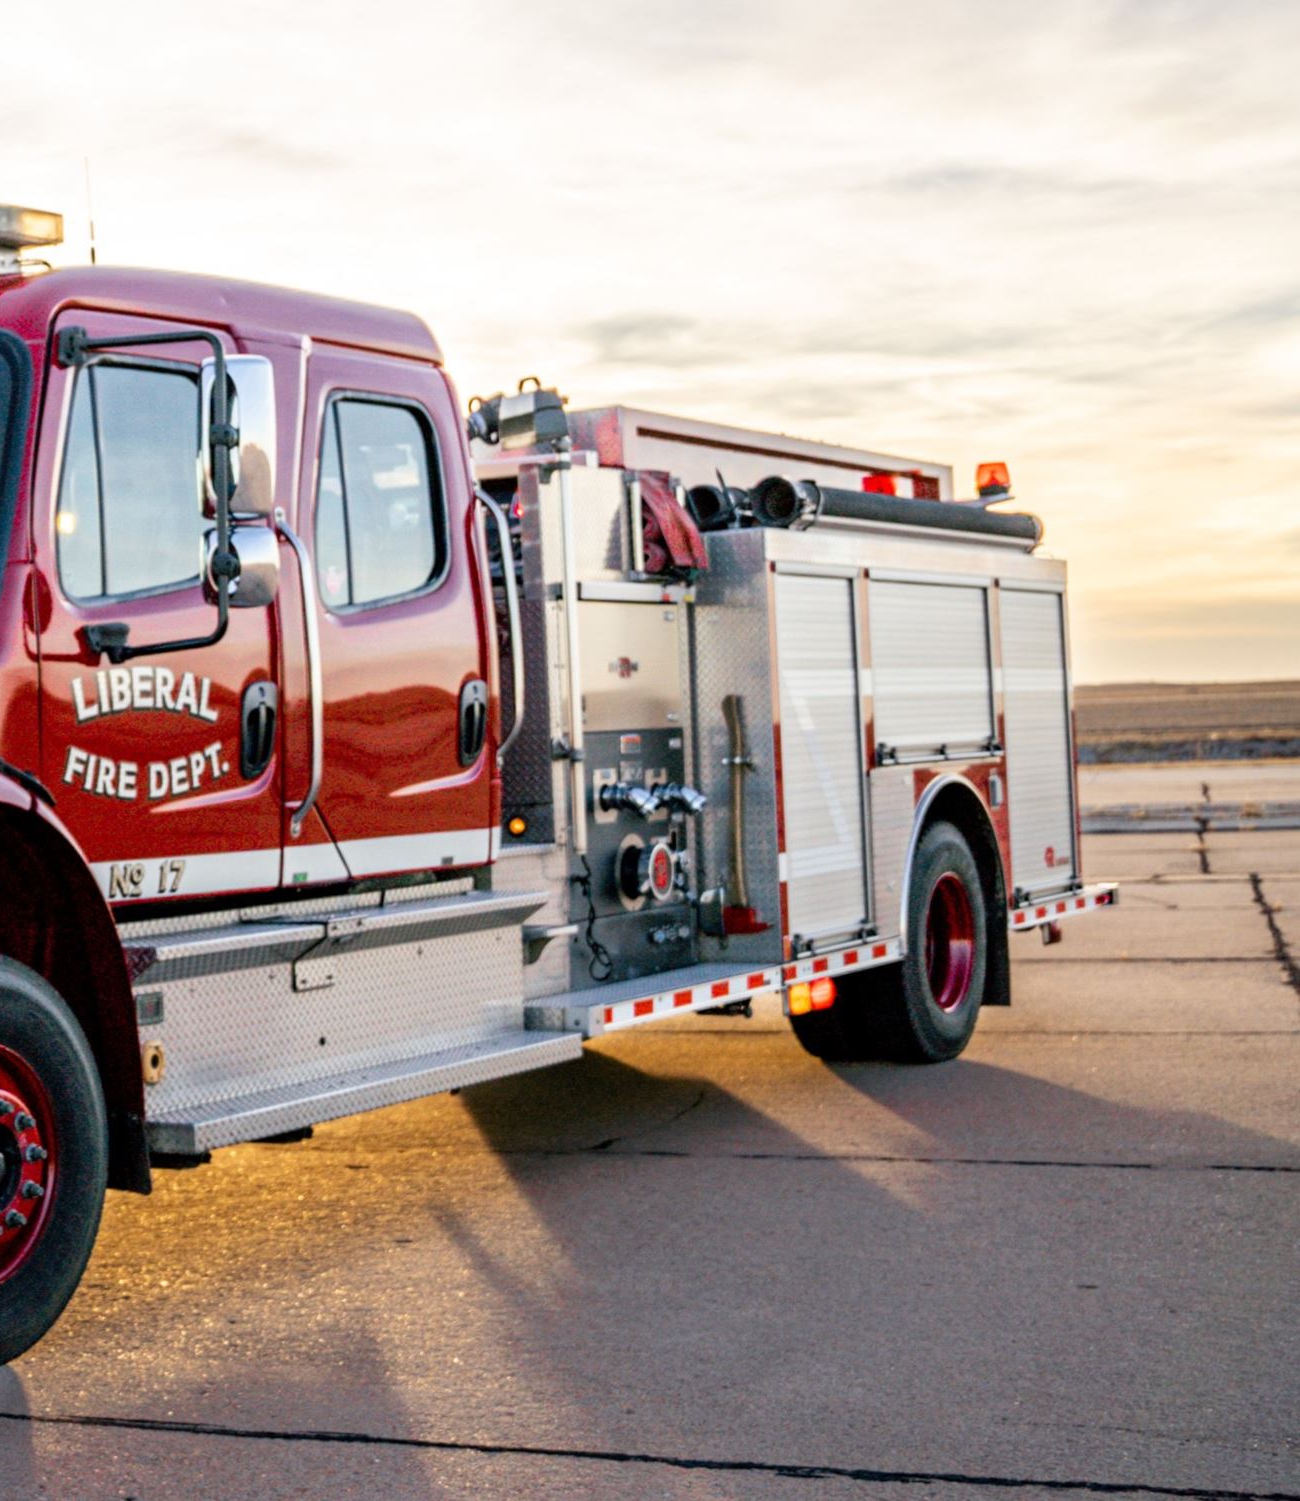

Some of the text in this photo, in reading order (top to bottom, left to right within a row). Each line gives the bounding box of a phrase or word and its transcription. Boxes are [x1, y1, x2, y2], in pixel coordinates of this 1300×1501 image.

[72, 666, 219, 723] LIBERAL
[63, 742, 229, 799] FIRE DEPT.
[158, 860, 186, 894] 17
